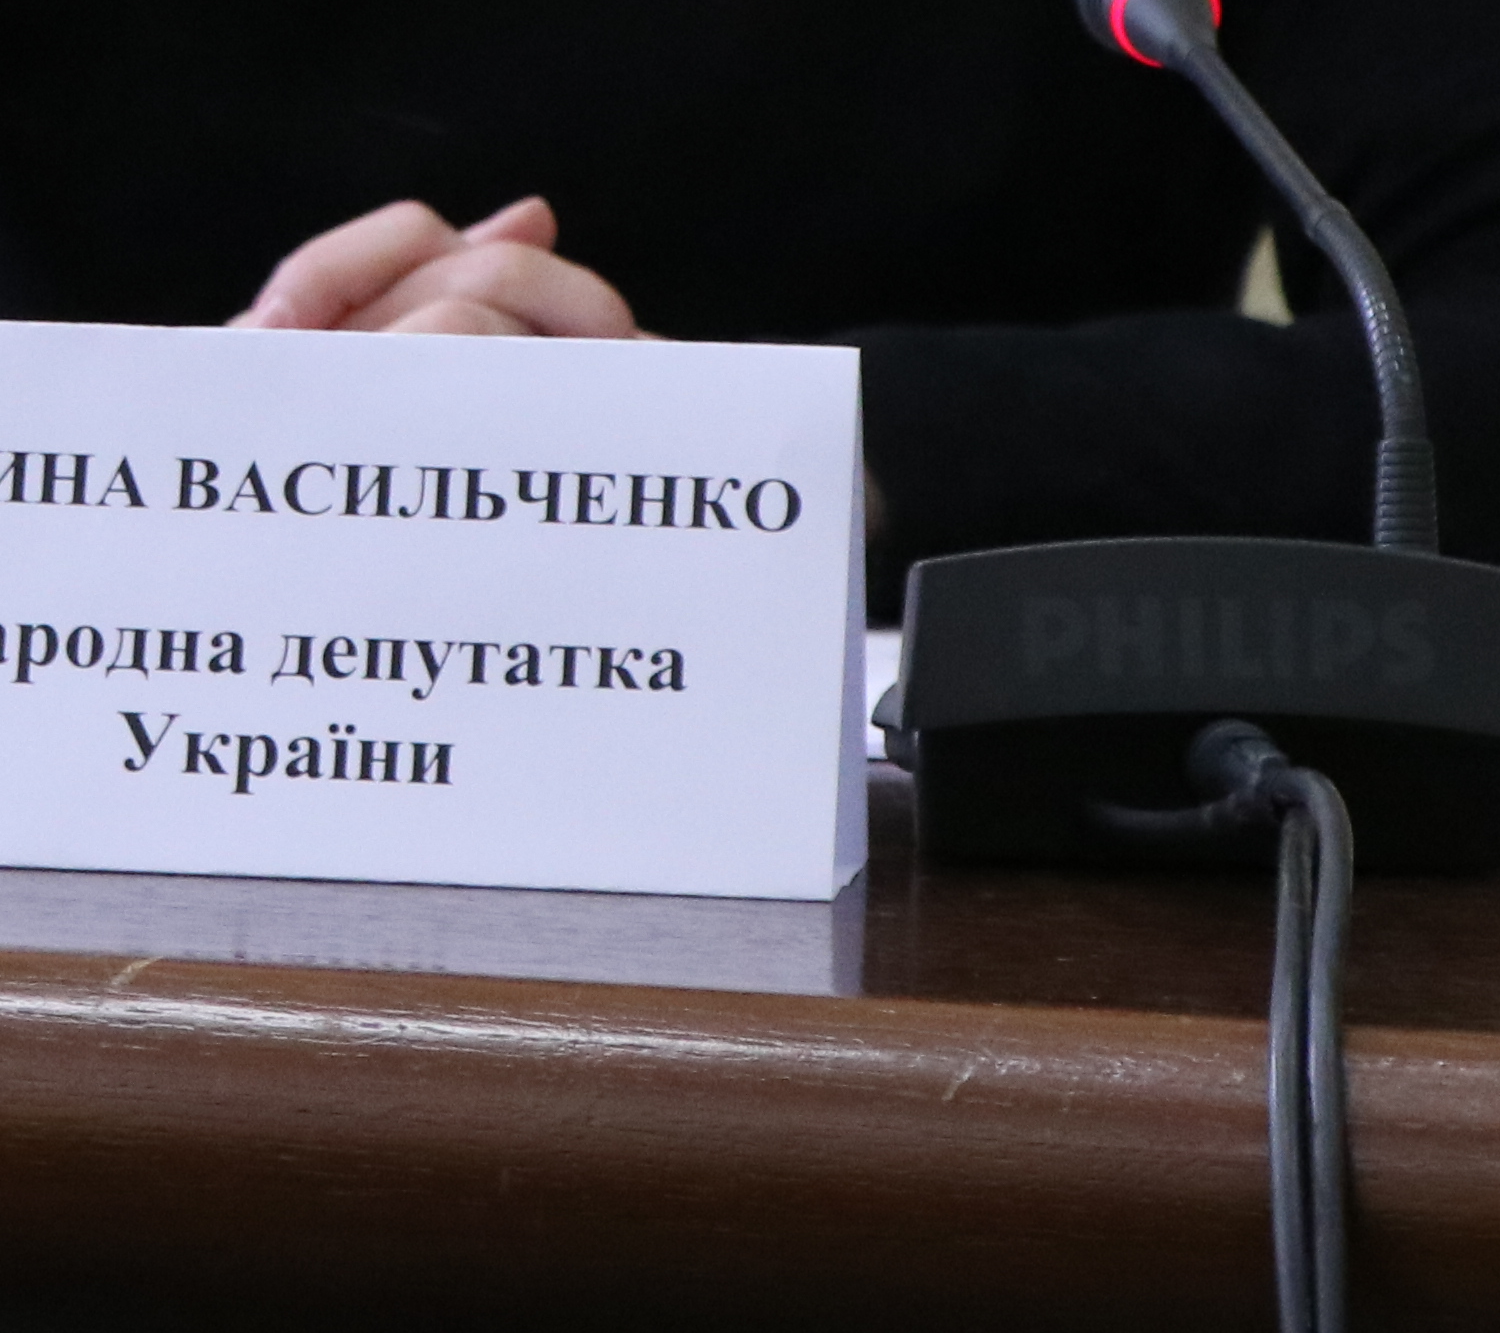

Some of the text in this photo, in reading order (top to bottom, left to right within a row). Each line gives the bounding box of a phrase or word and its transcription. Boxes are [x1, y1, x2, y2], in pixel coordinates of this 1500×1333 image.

[173, 456, 803, 533] ВАСИЛЬЧЕНКО
[270, 633, 687, 702] депутатка
[1020, 594, 1438, 685] PHILIPS
[120, 710, 455, 796] України
